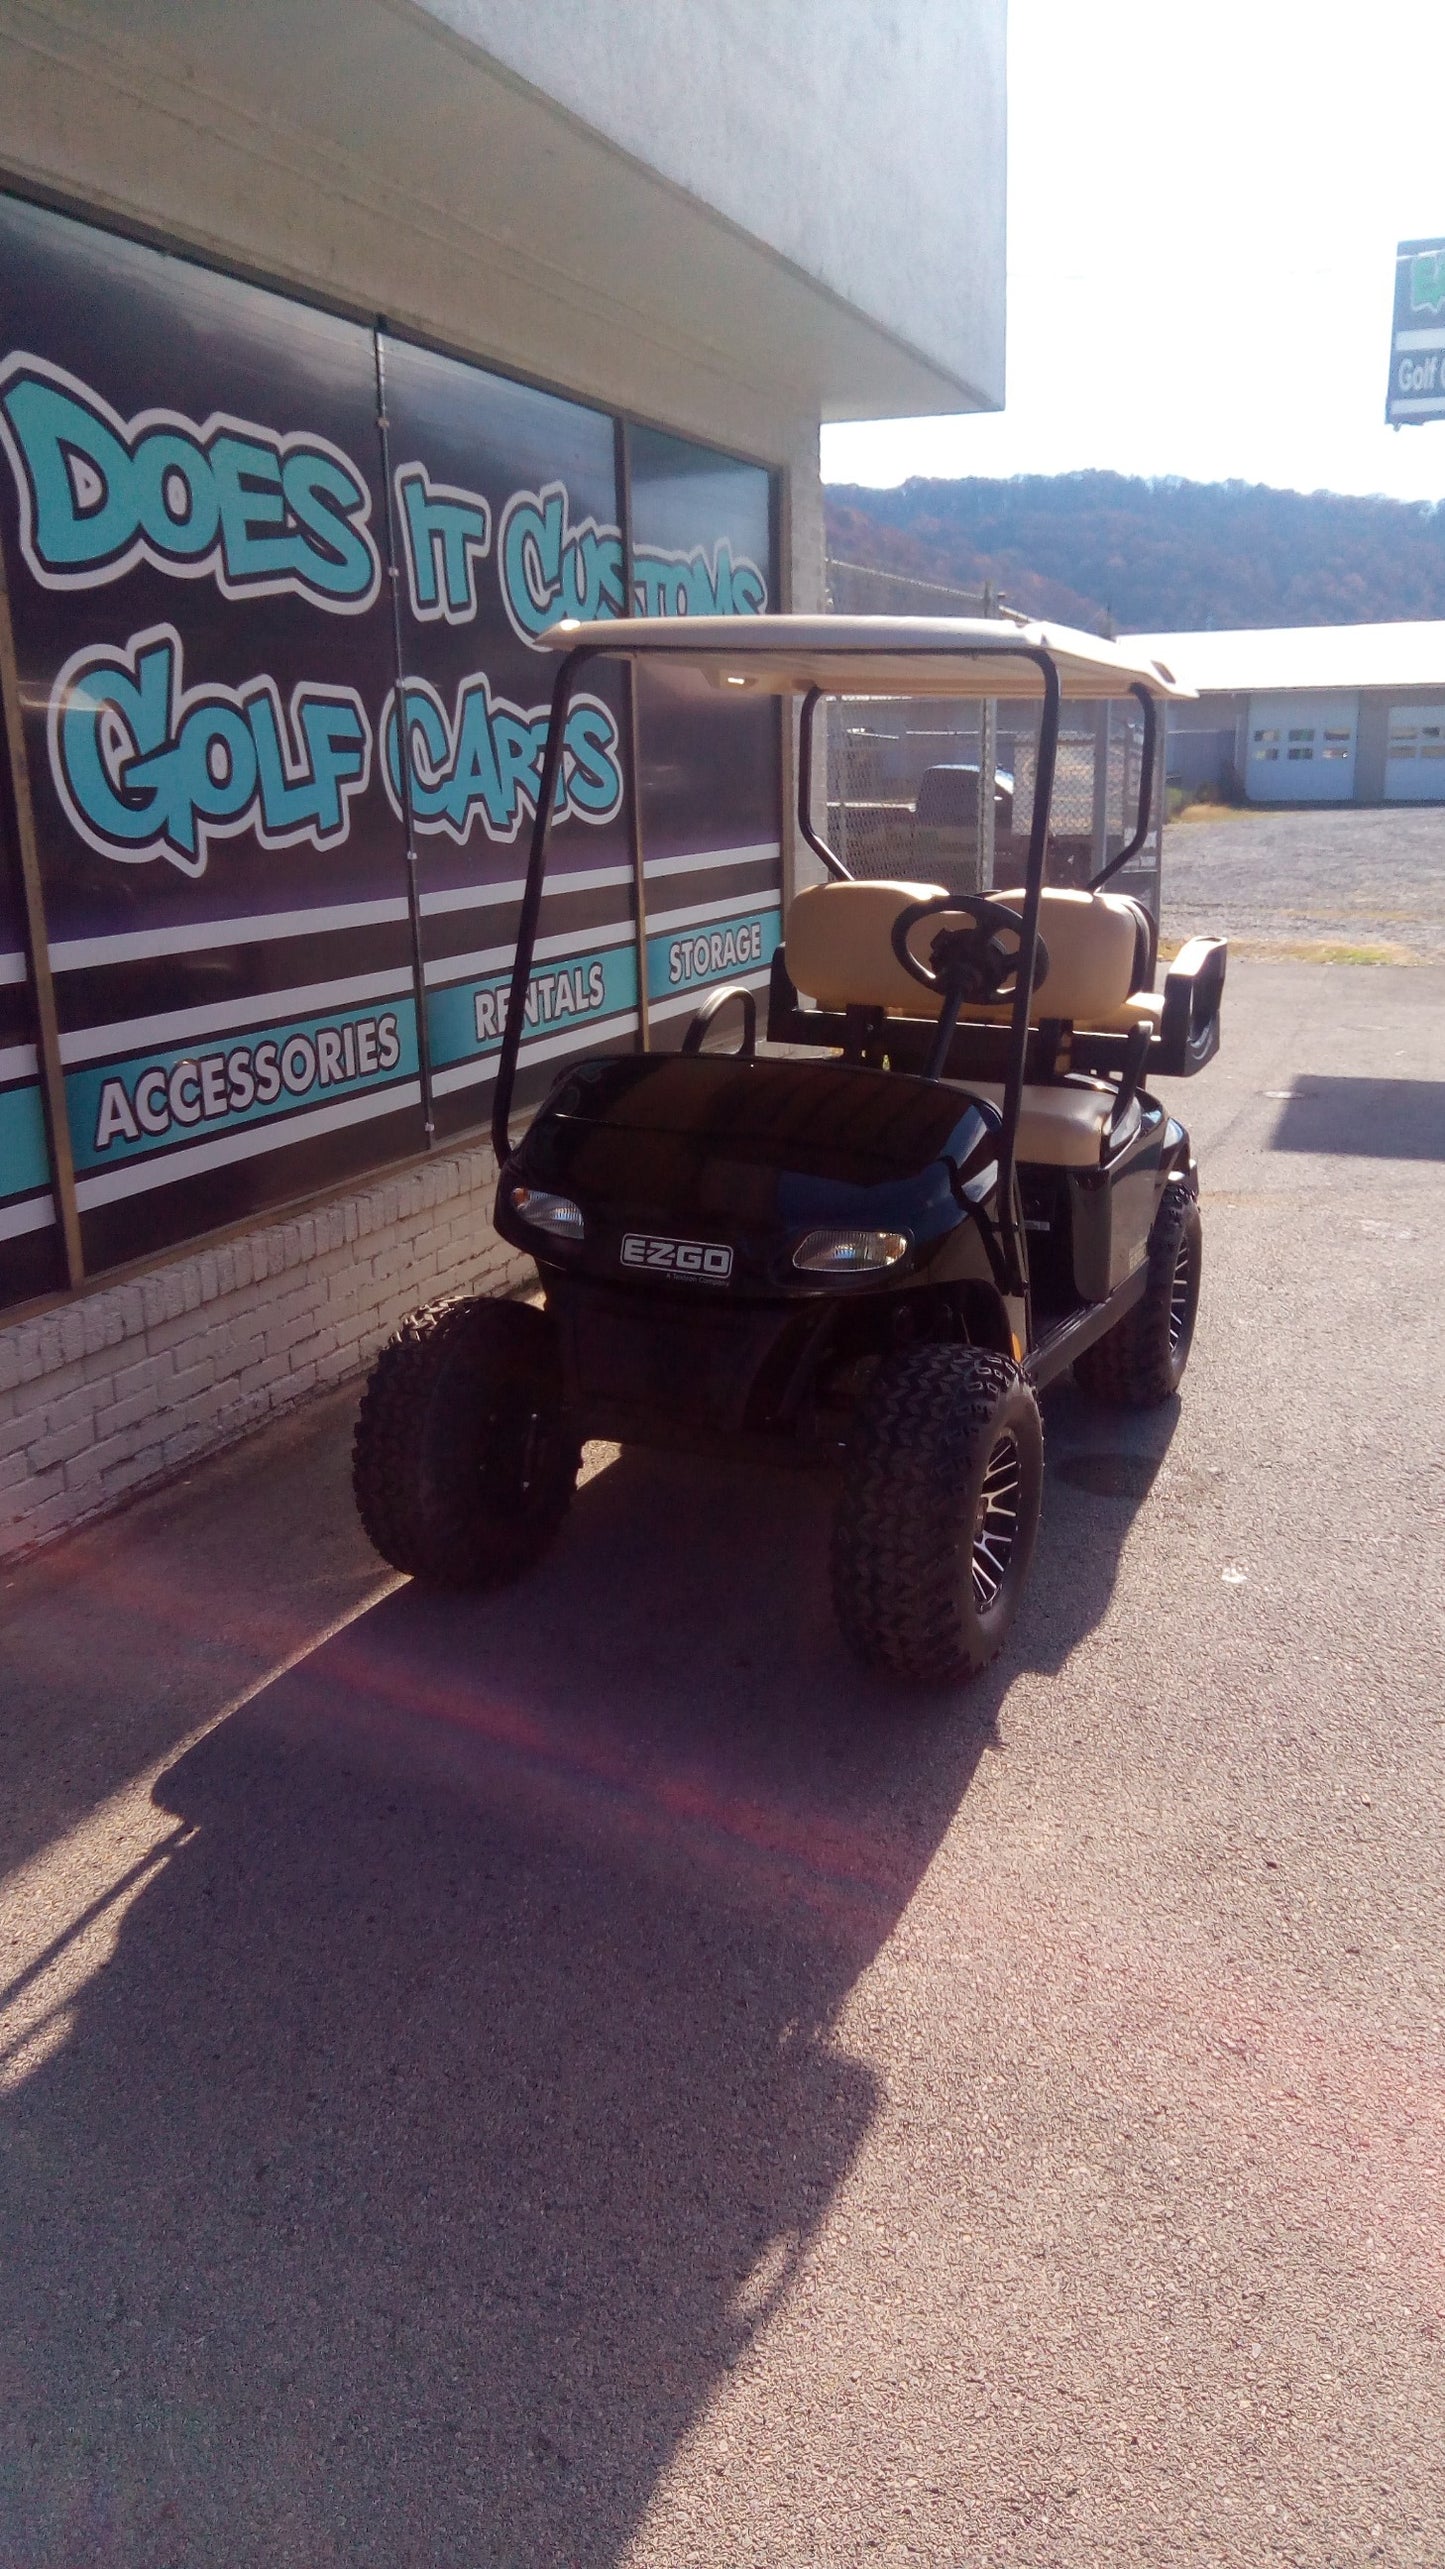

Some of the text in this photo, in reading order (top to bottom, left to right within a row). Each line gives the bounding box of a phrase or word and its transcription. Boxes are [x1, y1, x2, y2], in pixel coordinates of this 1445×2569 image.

[0, 350, 381, 614] DOES
[397, 460, 490, 623] IT
[48, 622, 372, 877] GOLF
[668, 922, 762, 984] STORAGE
[95, 1014, 400, 1153] ACCESSORIES
